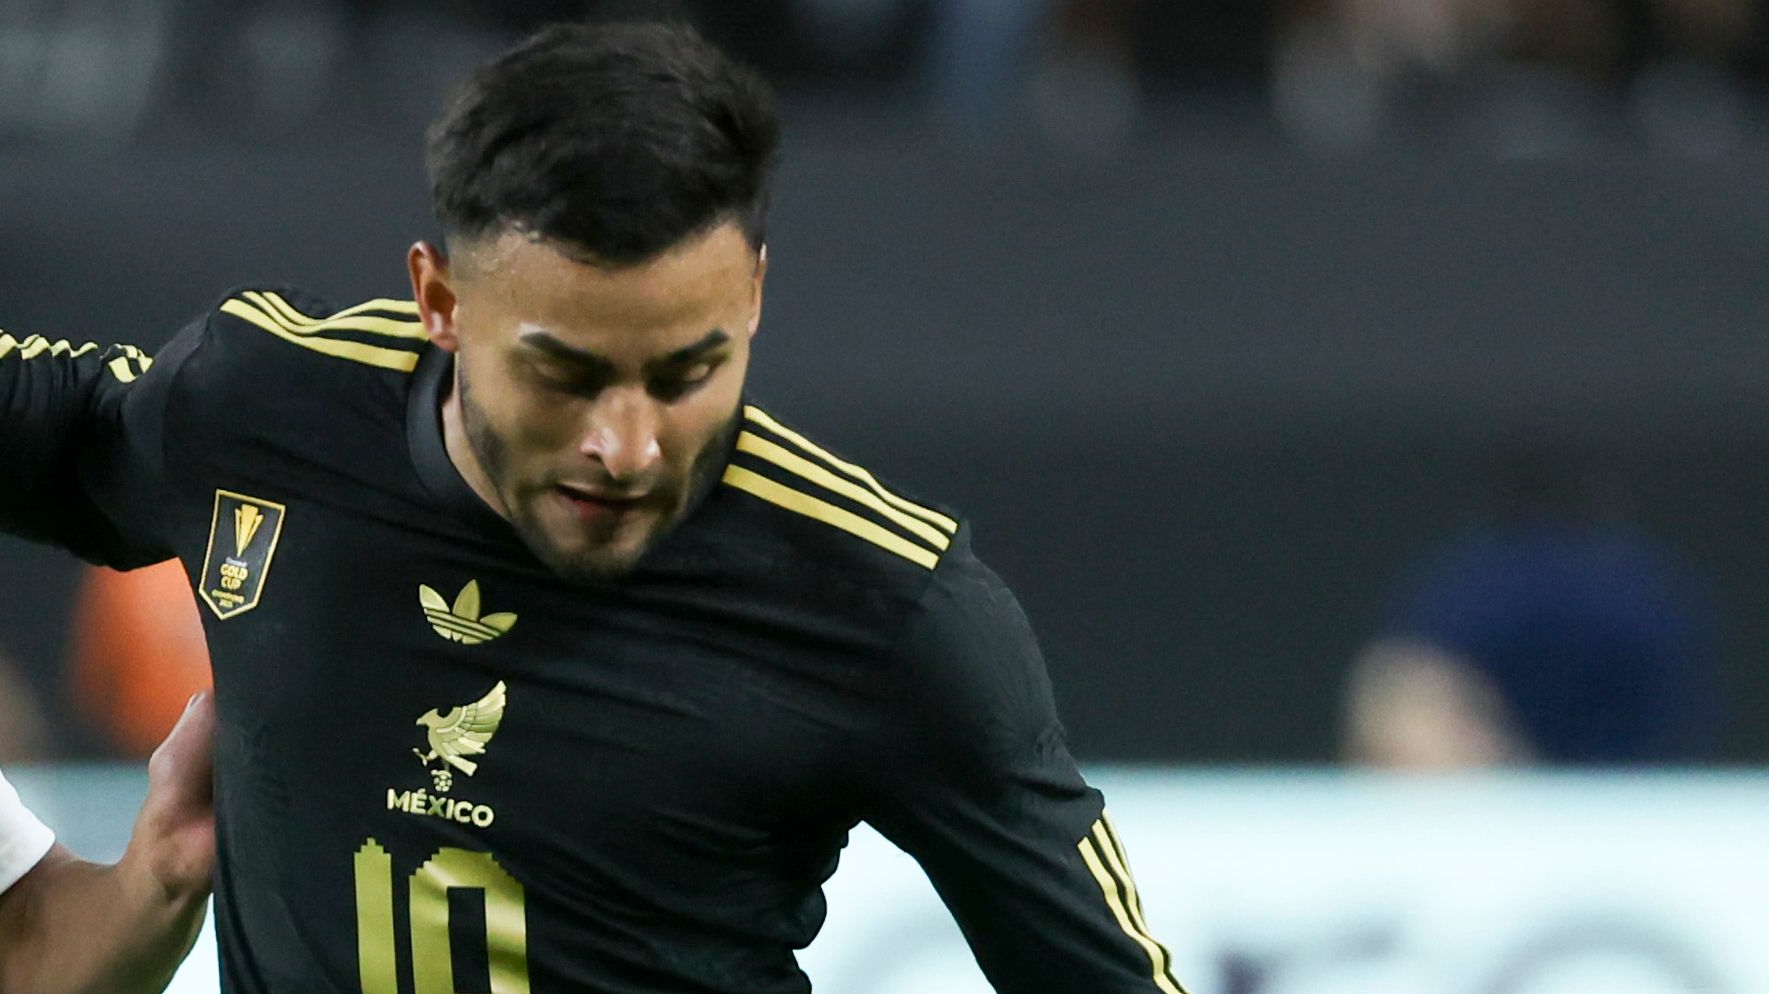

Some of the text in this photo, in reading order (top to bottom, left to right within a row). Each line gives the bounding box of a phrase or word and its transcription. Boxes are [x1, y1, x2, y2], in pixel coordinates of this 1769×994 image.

[220, 563, 249, 581] GOLD
[220, 575, 242, 590] CUP
[386, 788, 495, 828] MÉXICO
